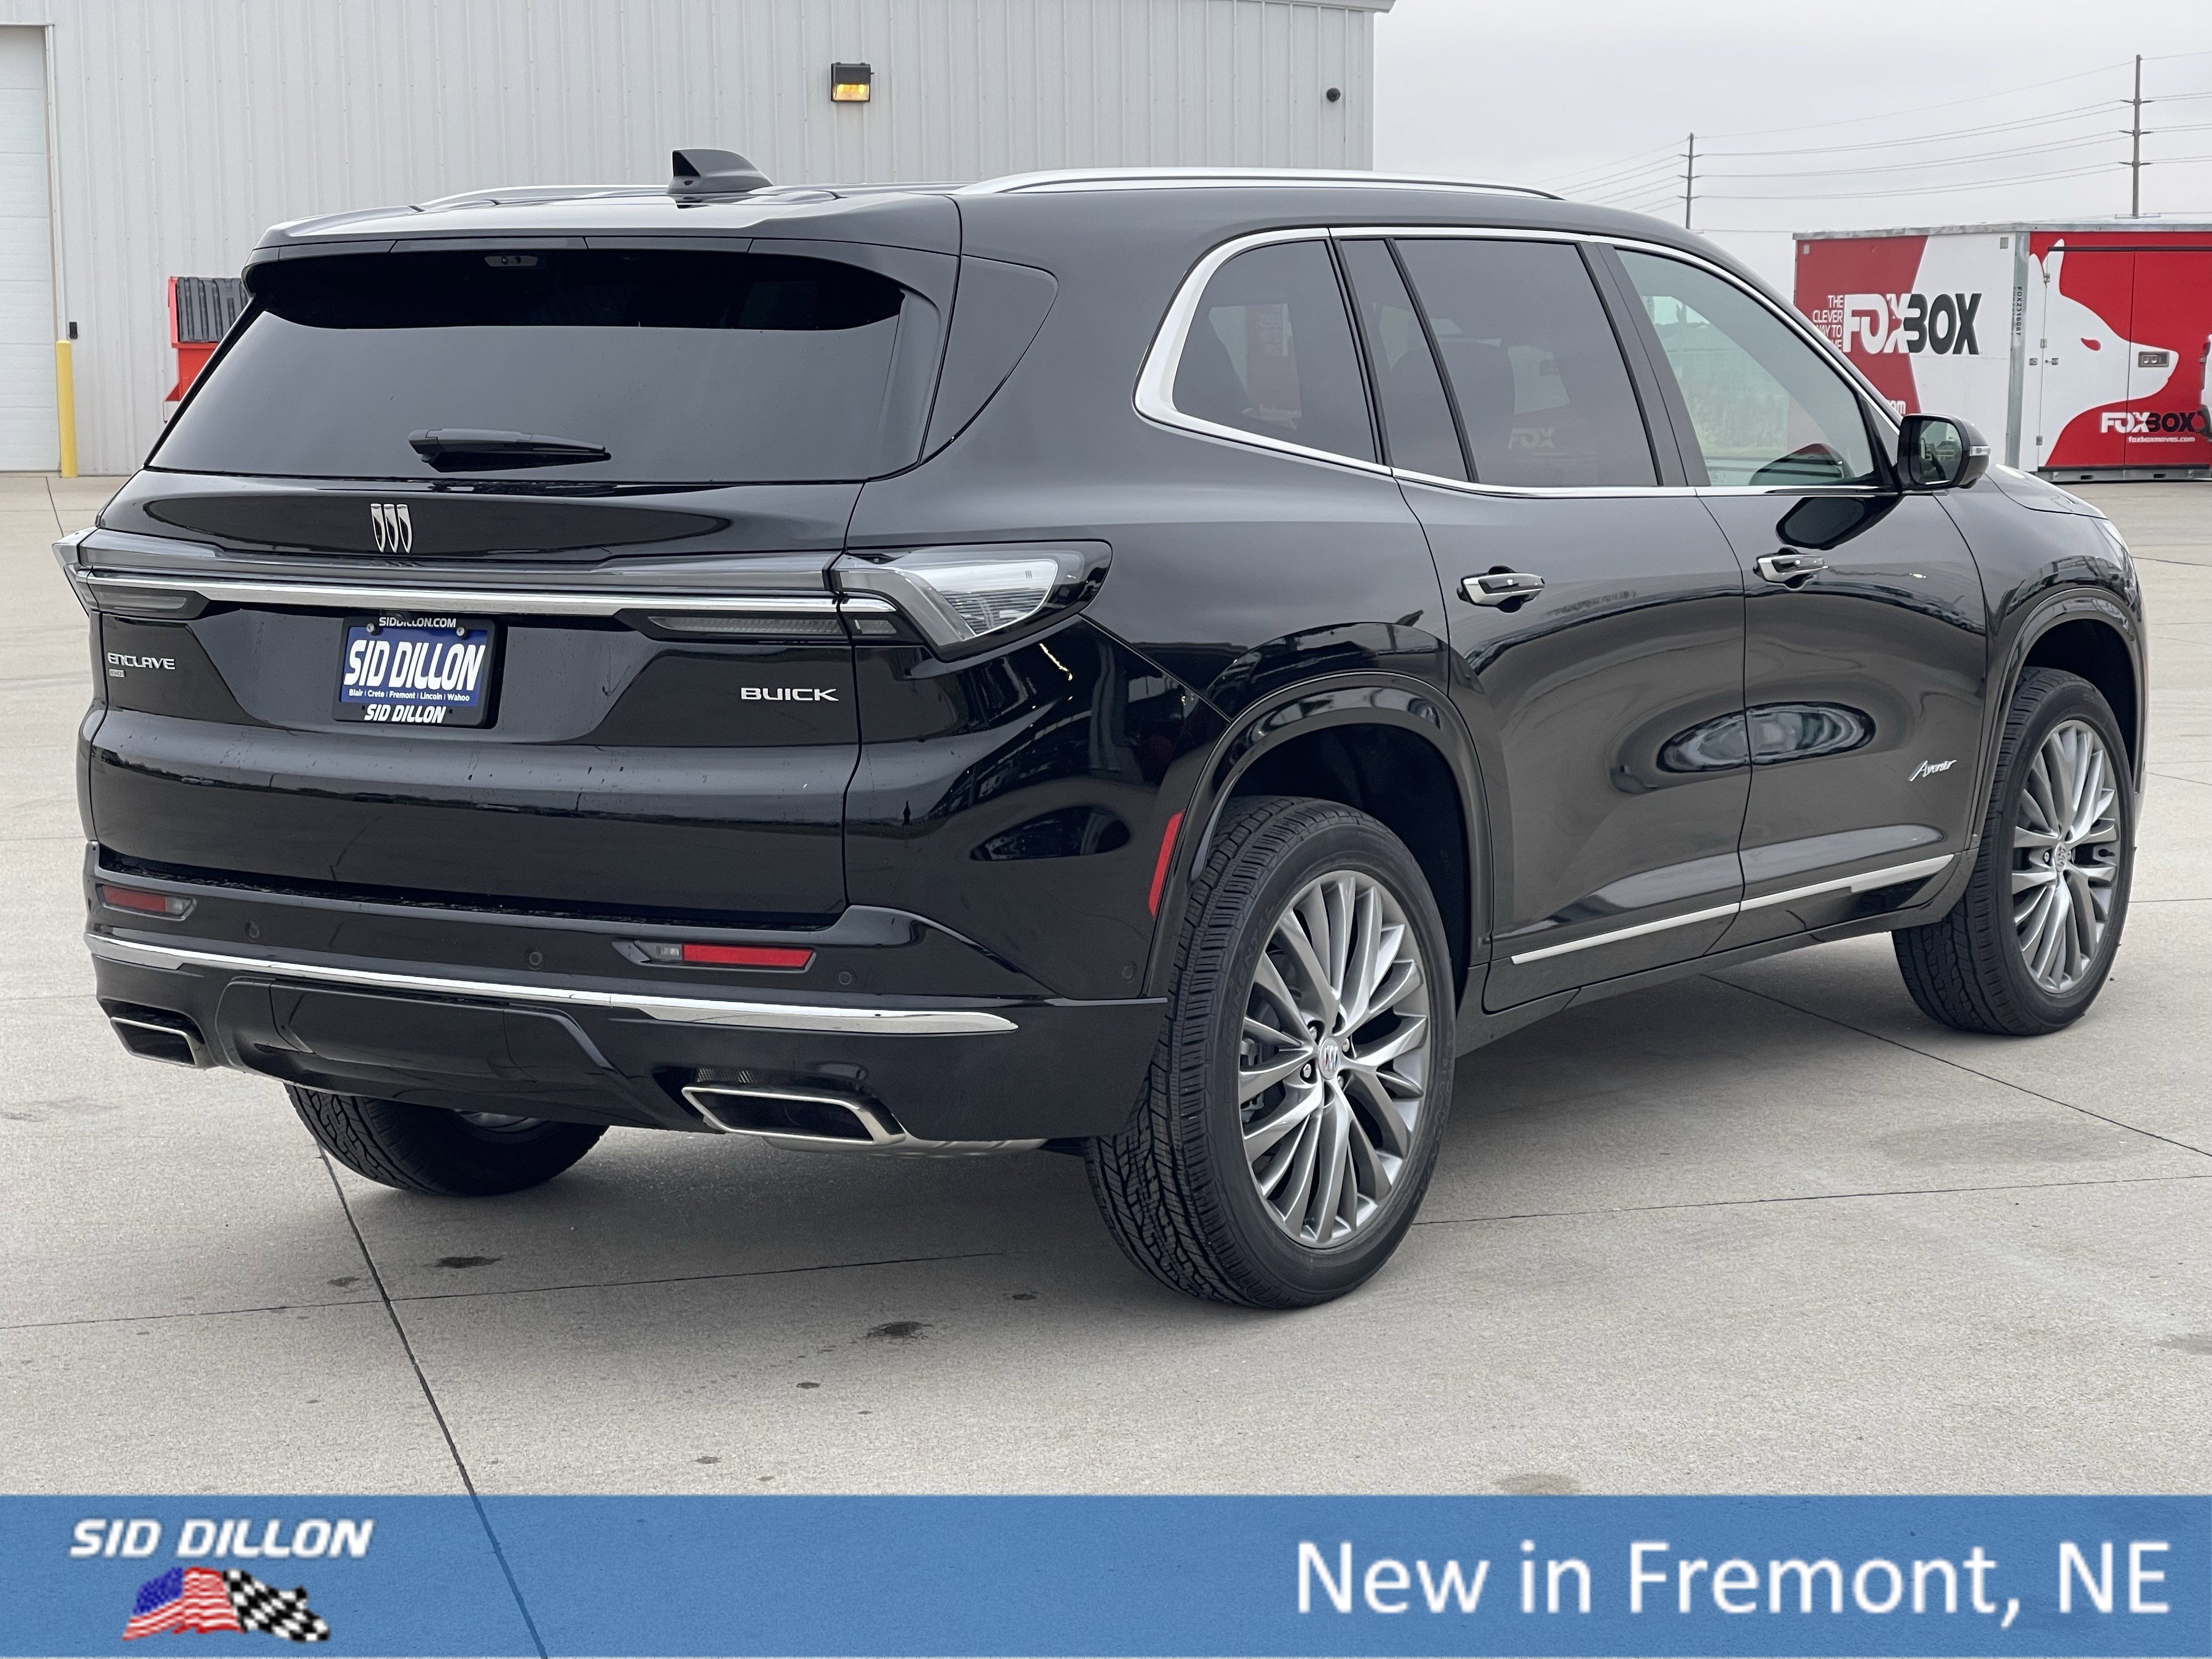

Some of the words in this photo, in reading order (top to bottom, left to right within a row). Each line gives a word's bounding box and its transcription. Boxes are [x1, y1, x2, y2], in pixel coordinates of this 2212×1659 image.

[1827, 295, 1844, 308] THE
[1813, 309, 1843, 323] CLEVER
[1842, 293, 1982, 355] FOXBOX
[1831, 324, 1843, 338] TO
[2101, 411, 2196, 433] FOXBOX
[108, 652, 176, 670] ENCLAVE
[344, 640, 390, 687] SID
[388, 641, 486, 691] DILLON
[349, 689, 363, 697] Blair
[368, 690, 385, 698] Crete
[420, 692, 443, 701] Lincoln
[447, 693, 470, 701] Wahoo
[741, 687, 839, 701] BUICK
[364, 704, 391, 721] SID
[391, 705, 447, 724] DILLON
